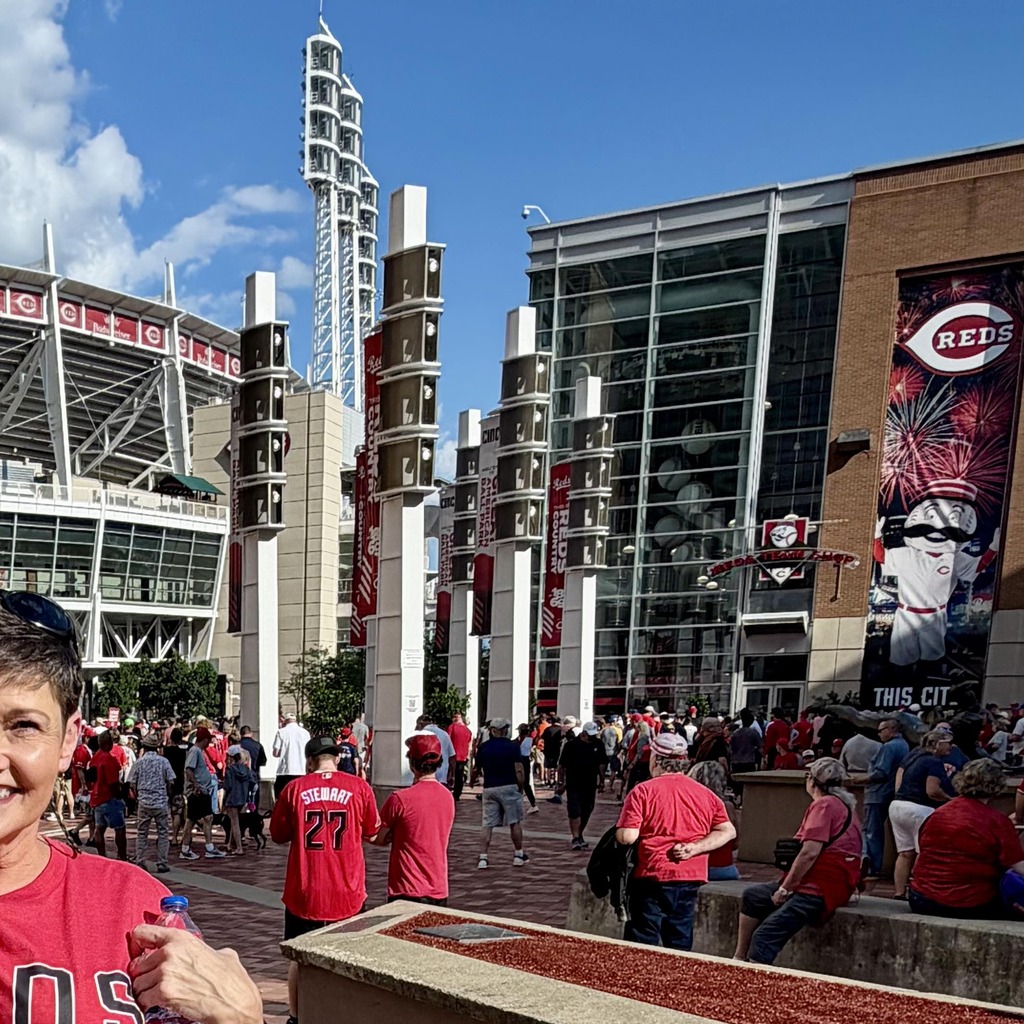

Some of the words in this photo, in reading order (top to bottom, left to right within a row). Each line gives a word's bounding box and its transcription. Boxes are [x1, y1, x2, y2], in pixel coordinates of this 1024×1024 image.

[936, 324, 1014, 350] REDS
[551, 510, 559, 575] COUNTRY
[557, 509, 569, 574] REDS
[873, 687, 913, 707] THIS
[921, 686, 958, 707] CIT
[300, 786, 353, 806] STEWART
[304, 809, 349, 850] 27
